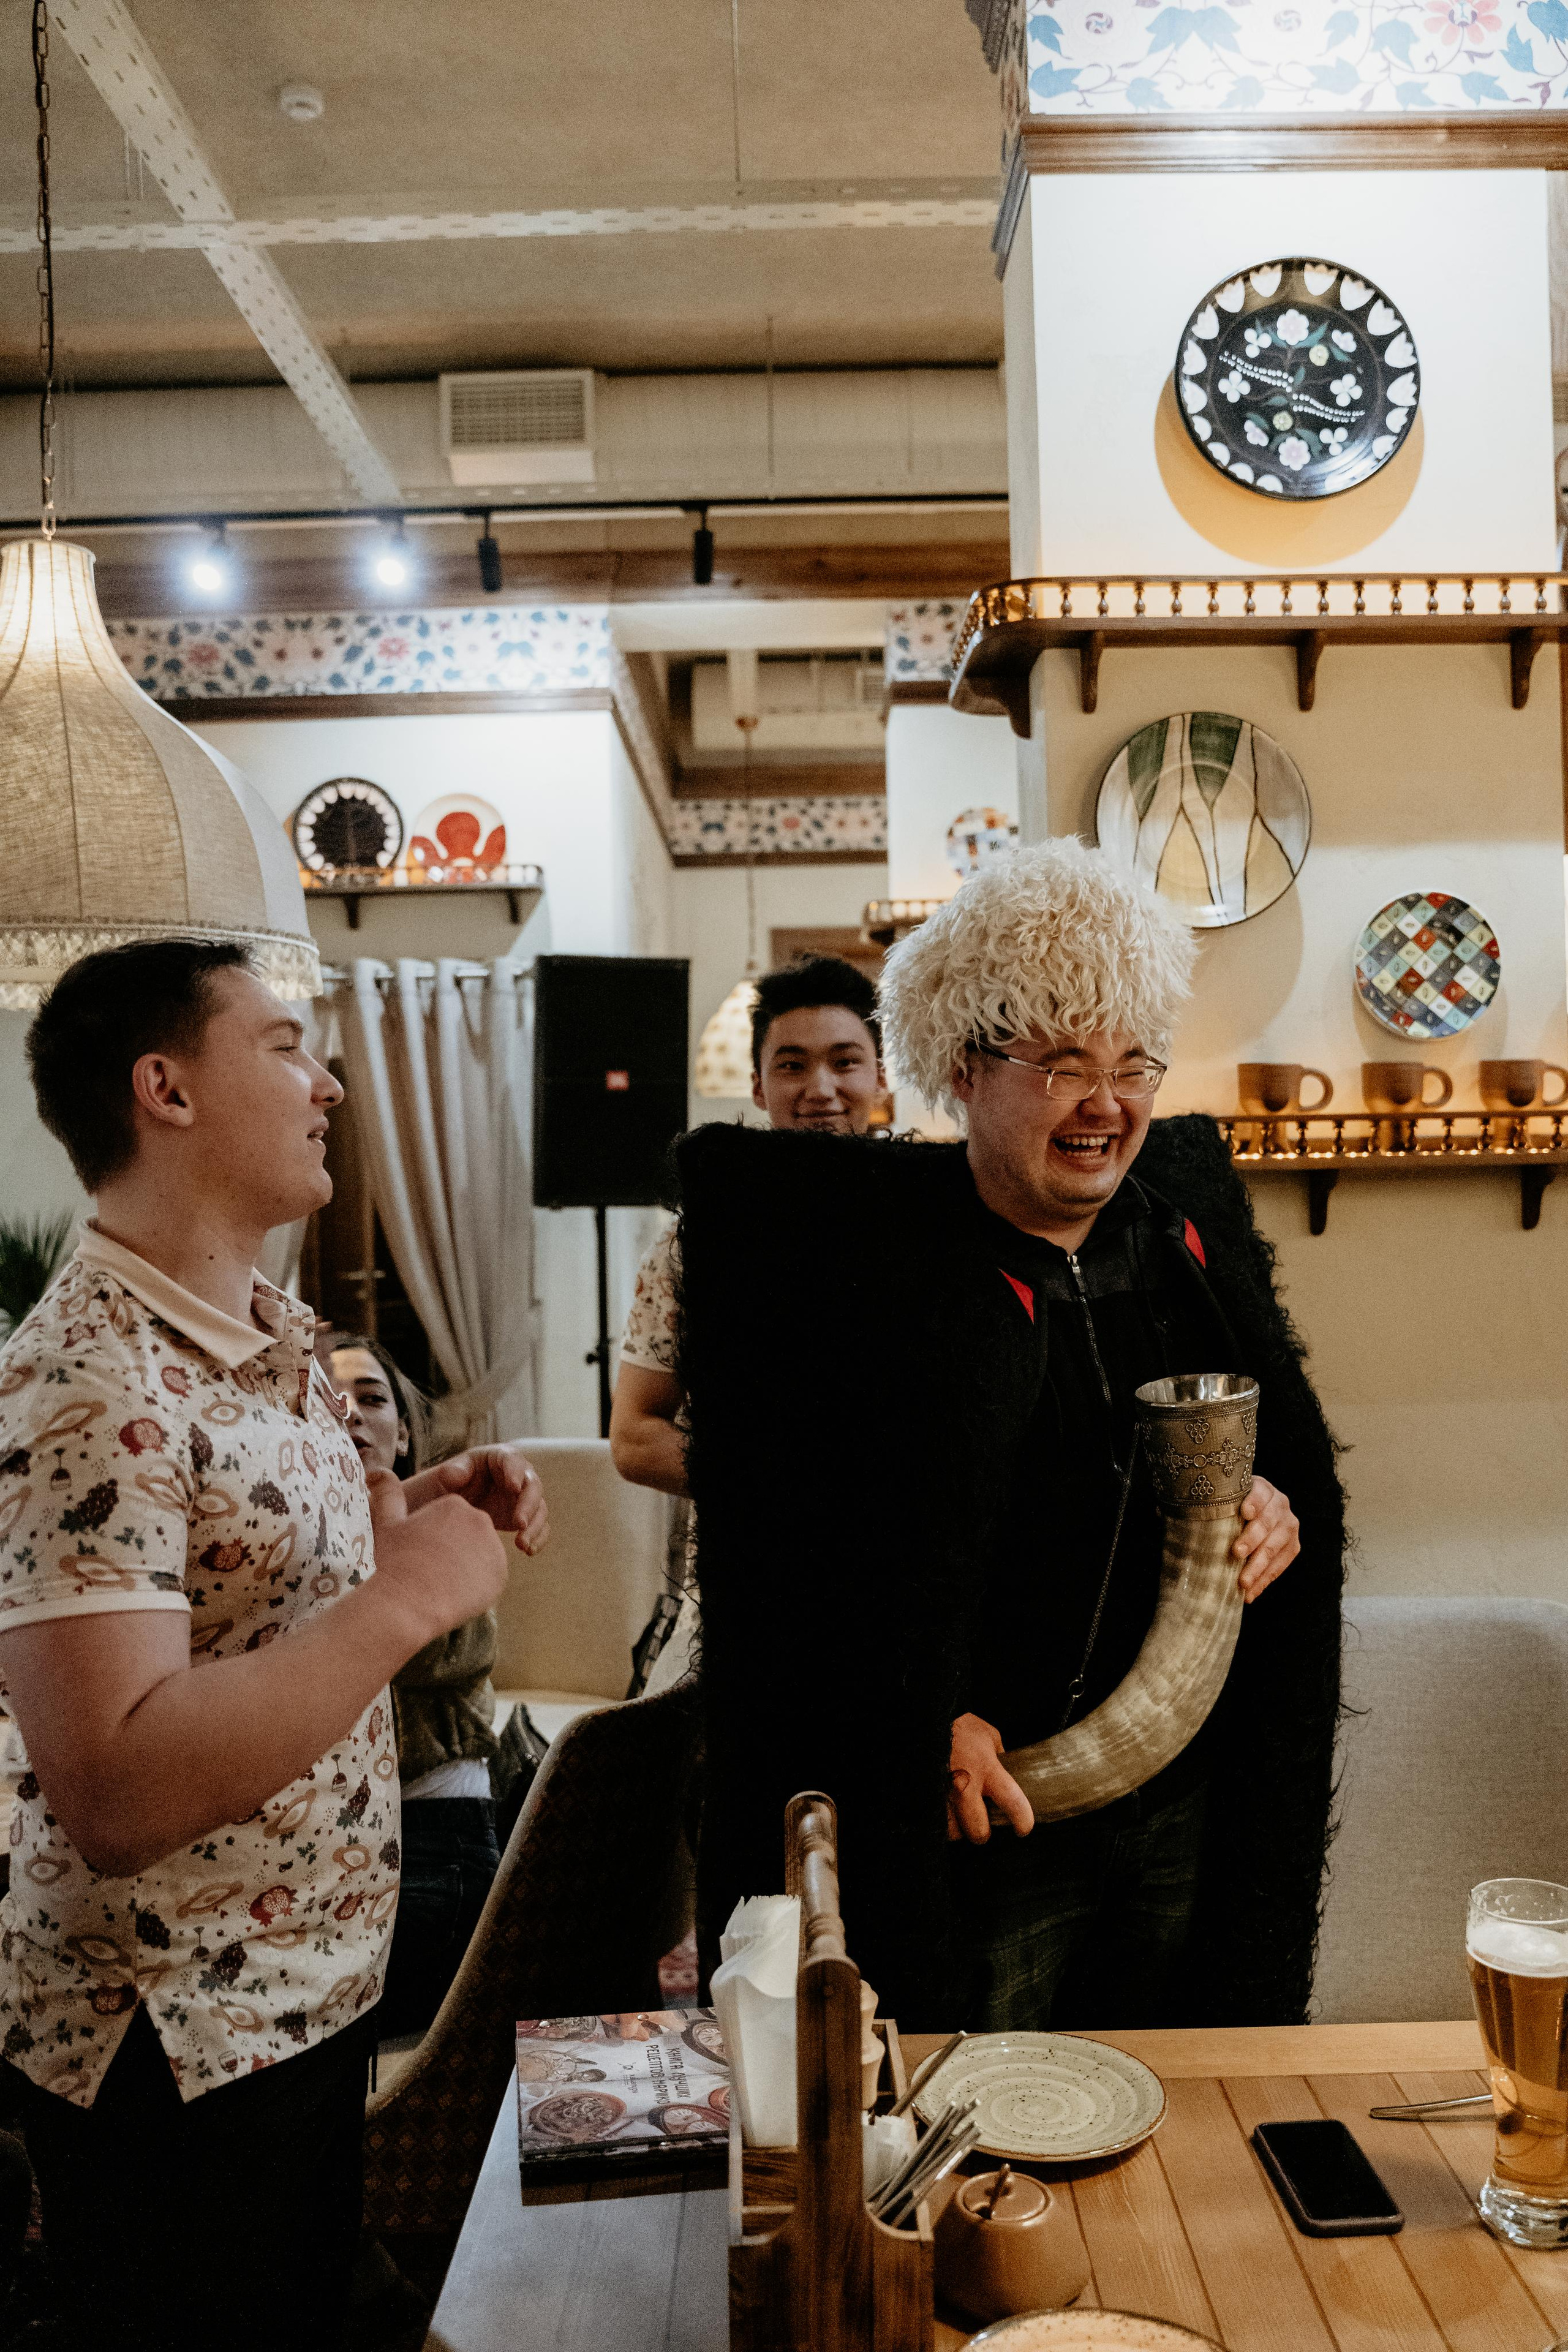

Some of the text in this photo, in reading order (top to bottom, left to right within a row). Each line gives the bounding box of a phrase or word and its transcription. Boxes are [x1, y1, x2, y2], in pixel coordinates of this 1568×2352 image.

[646, 2045, 671, 2104] РЕЦЕПТОВ МАРИКО
[665, 2048, 691, 2098] КНИГА ЛУЧШИХ
